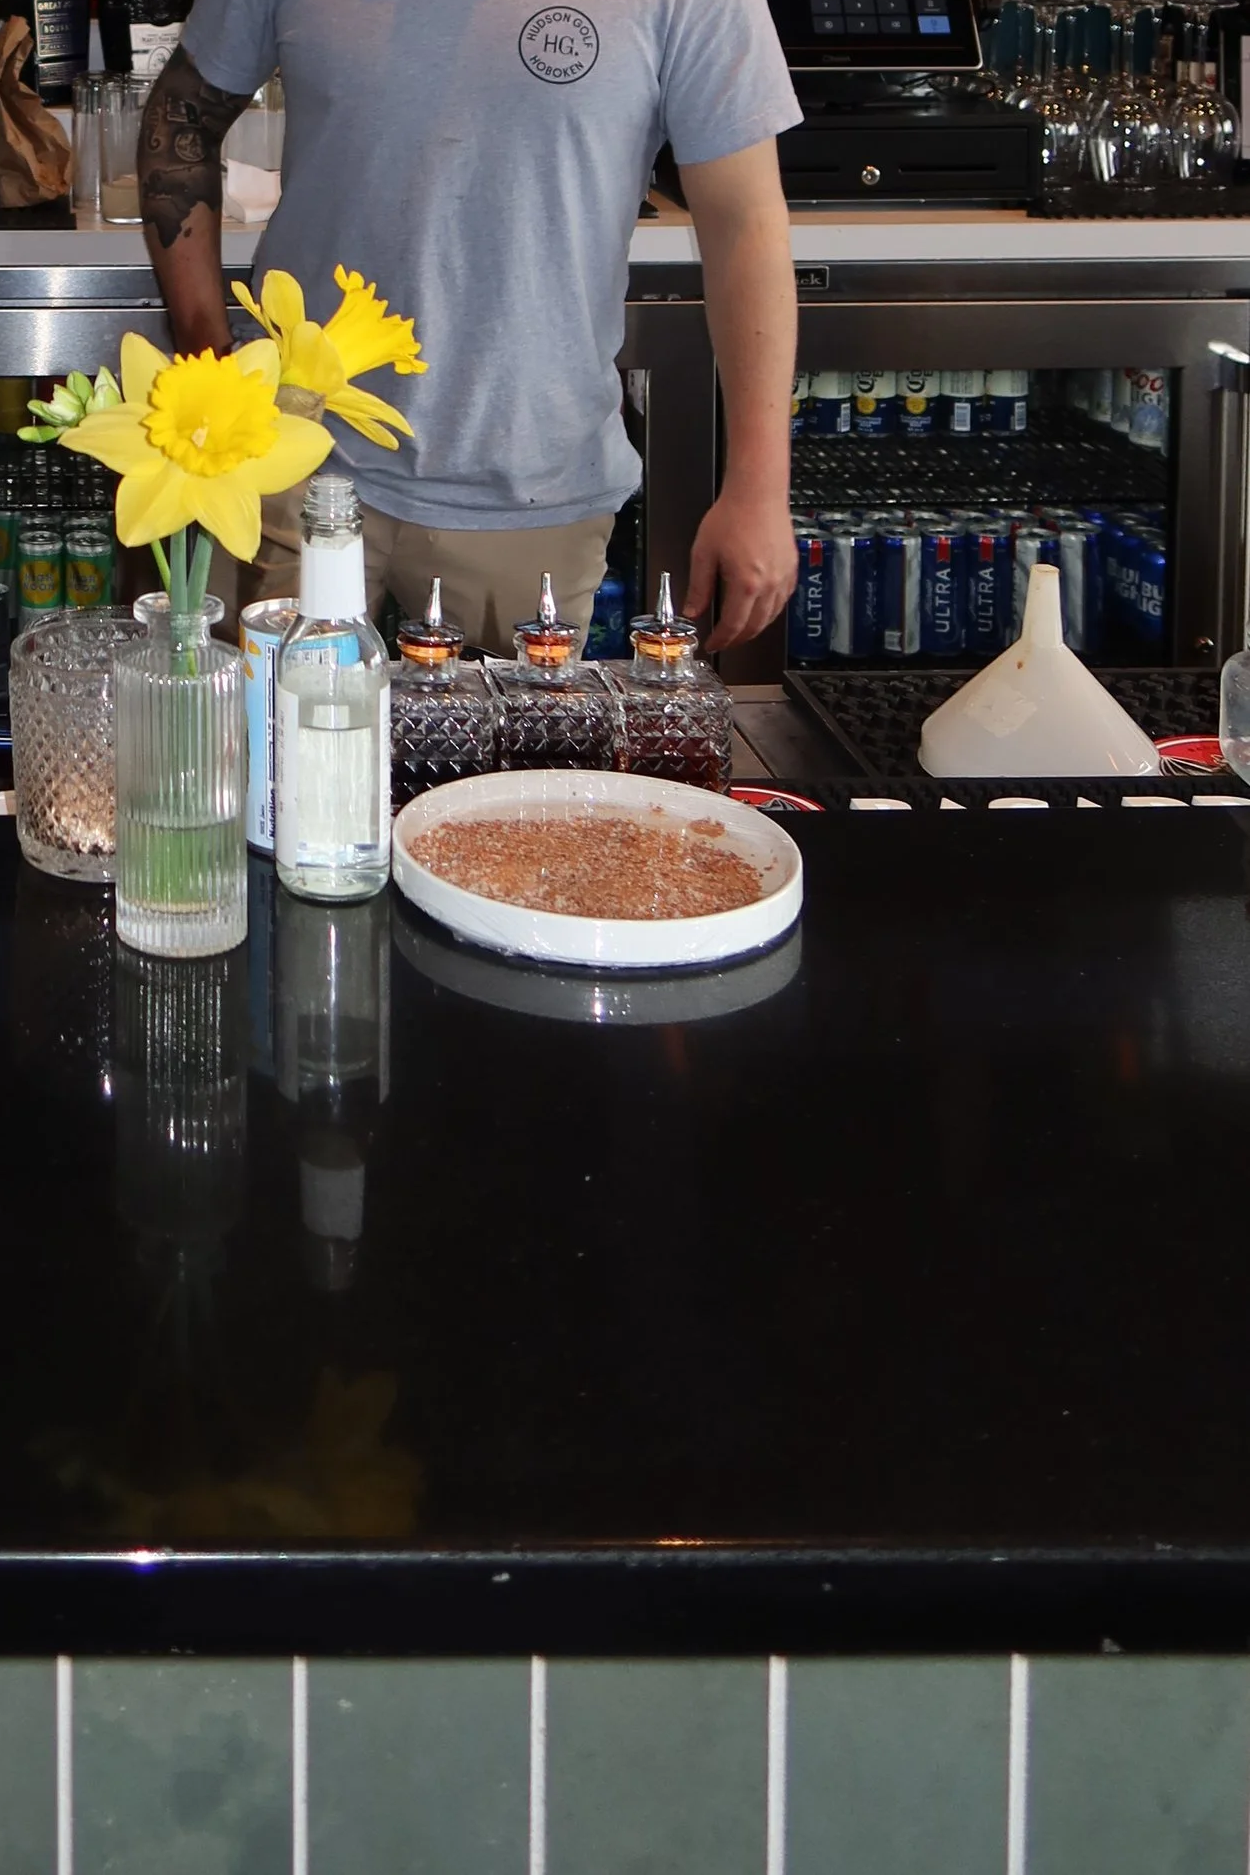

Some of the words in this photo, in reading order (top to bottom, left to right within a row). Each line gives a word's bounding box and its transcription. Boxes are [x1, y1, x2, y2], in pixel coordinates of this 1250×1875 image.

[526, 11, 572, 42] HUDSON
[572, 17, 594, 49] GOLF
[529, 54, 585, 78] HOBOKEN
[807, 571, 823, 638] ULTRA
[934, 567, 952, 634] ULTRA
[977, 566, 995, 633] ULTRA
